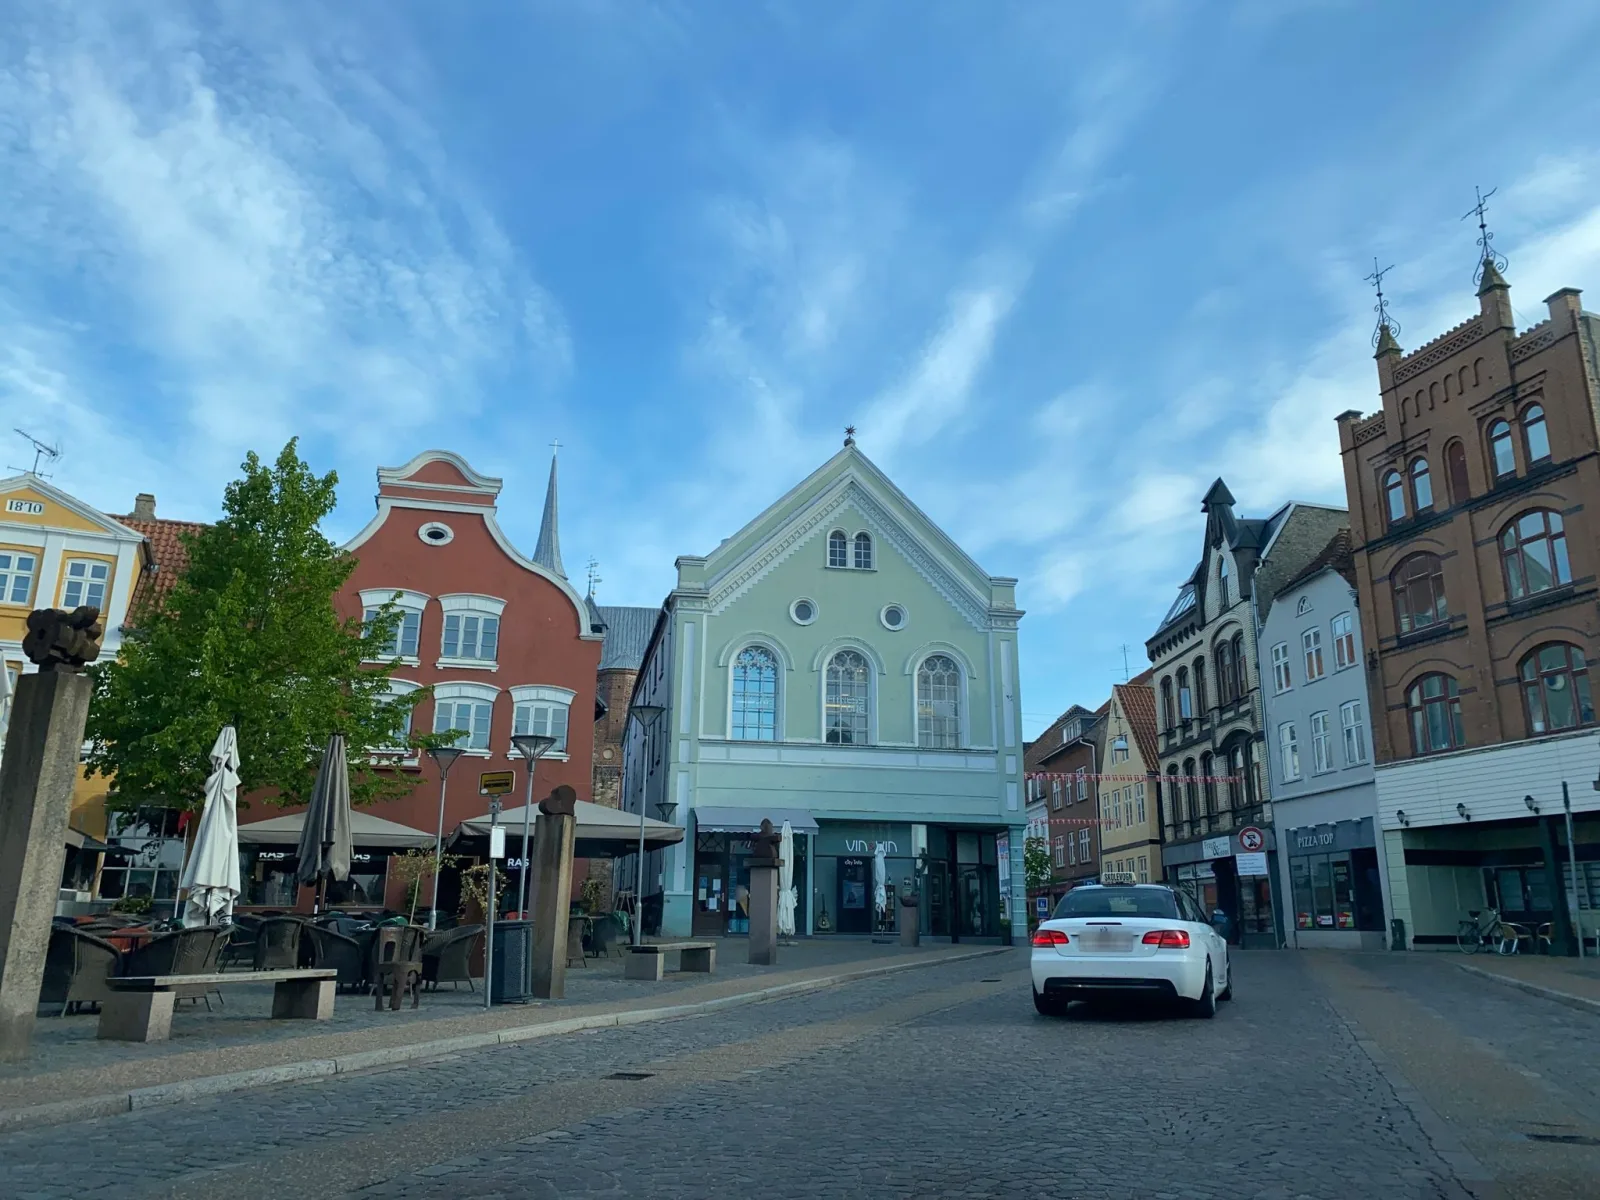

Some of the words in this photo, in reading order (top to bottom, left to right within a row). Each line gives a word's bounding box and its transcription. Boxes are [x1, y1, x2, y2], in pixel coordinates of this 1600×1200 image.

[9, 500, 42, 513] 1870
[1298, 835, 1319, 848] PIZZA
[1319, 833, 1334, 845] TOP
[507, 858, 530, 867] RAS
[1104, 872, 1133, 881] SKOLEVOGN
